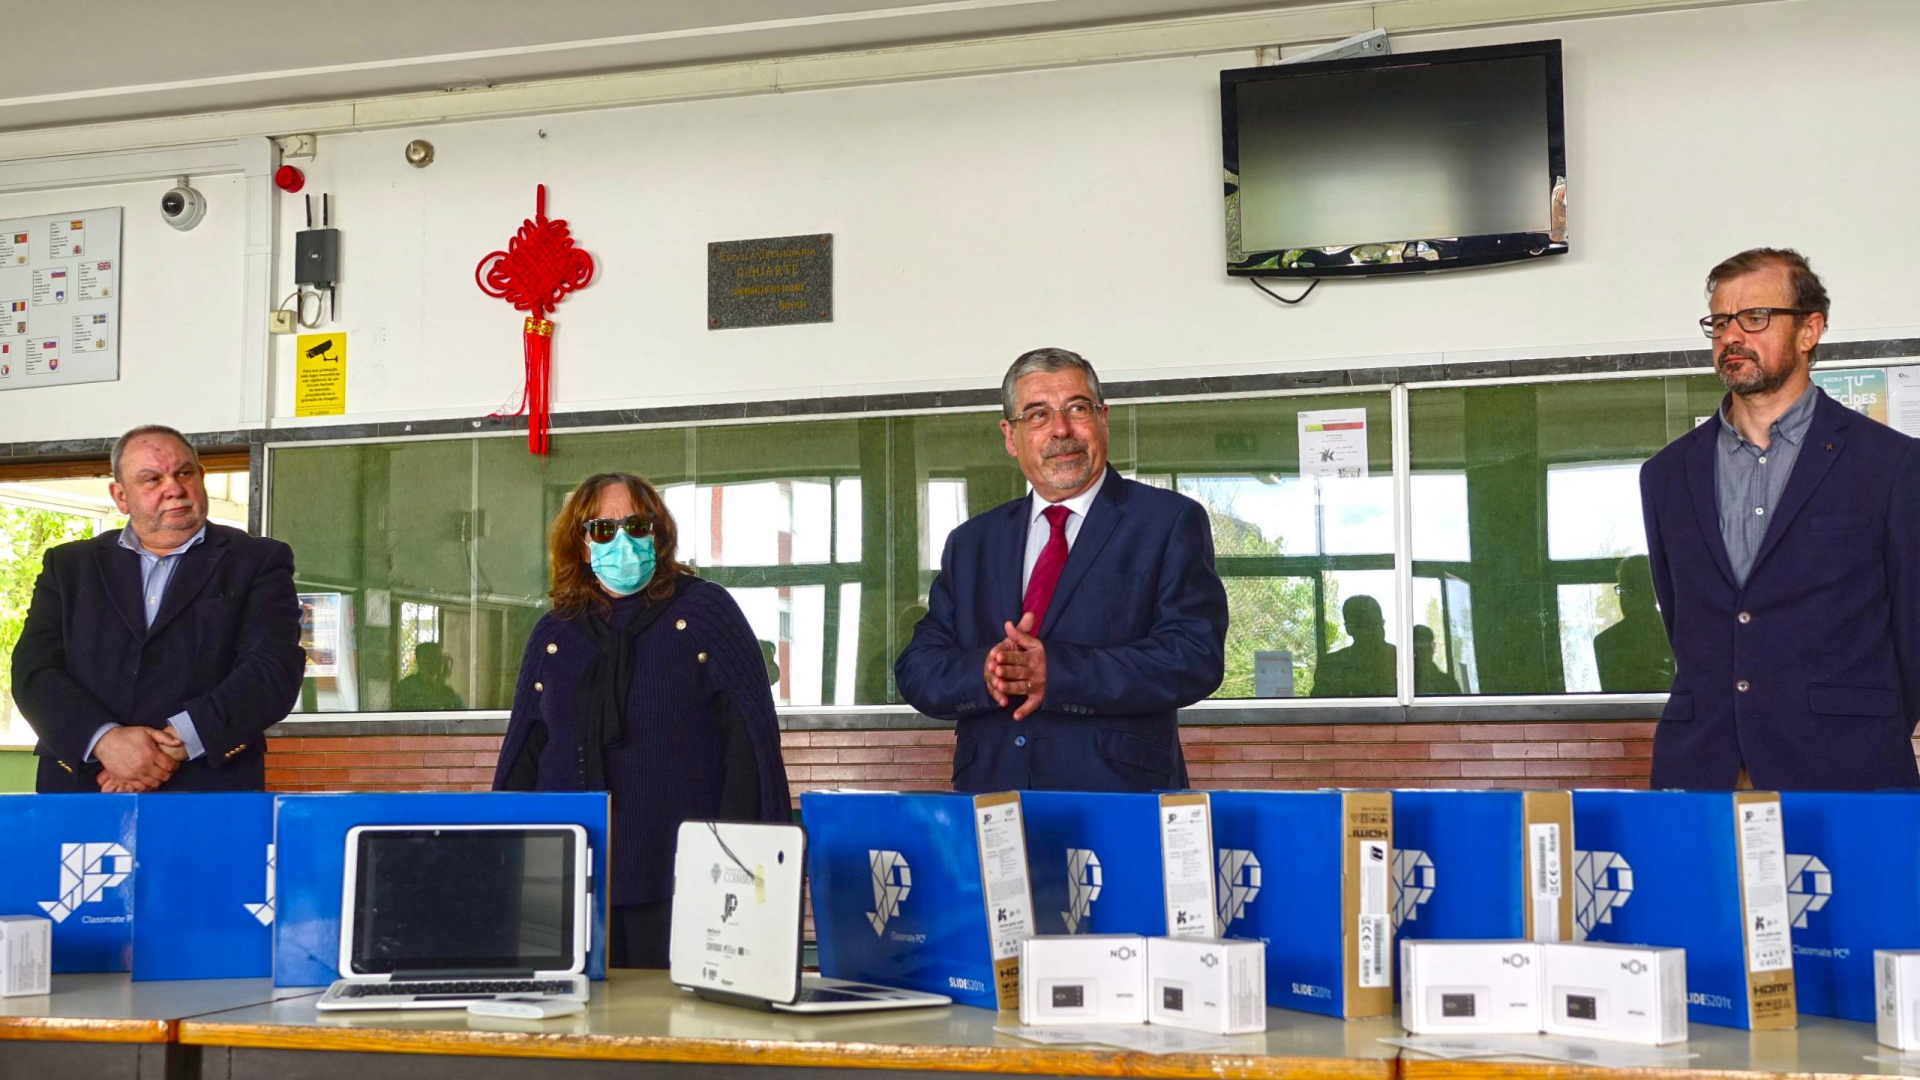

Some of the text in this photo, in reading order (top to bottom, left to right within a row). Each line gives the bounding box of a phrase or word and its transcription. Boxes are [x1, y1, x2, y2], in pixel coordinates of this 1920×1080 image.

[1829, 393, 1877, 405] ECIDES
[81, 915, 125, 924] Classmate
[1110, 946, 1137, 961] NOS
[1200, 952, 1219, 968] NOS
[1502, 953, 1531, 969] NOS
[1001, 967, 1019, 977] HD
[1620, 959, 1648, 975] NOS
